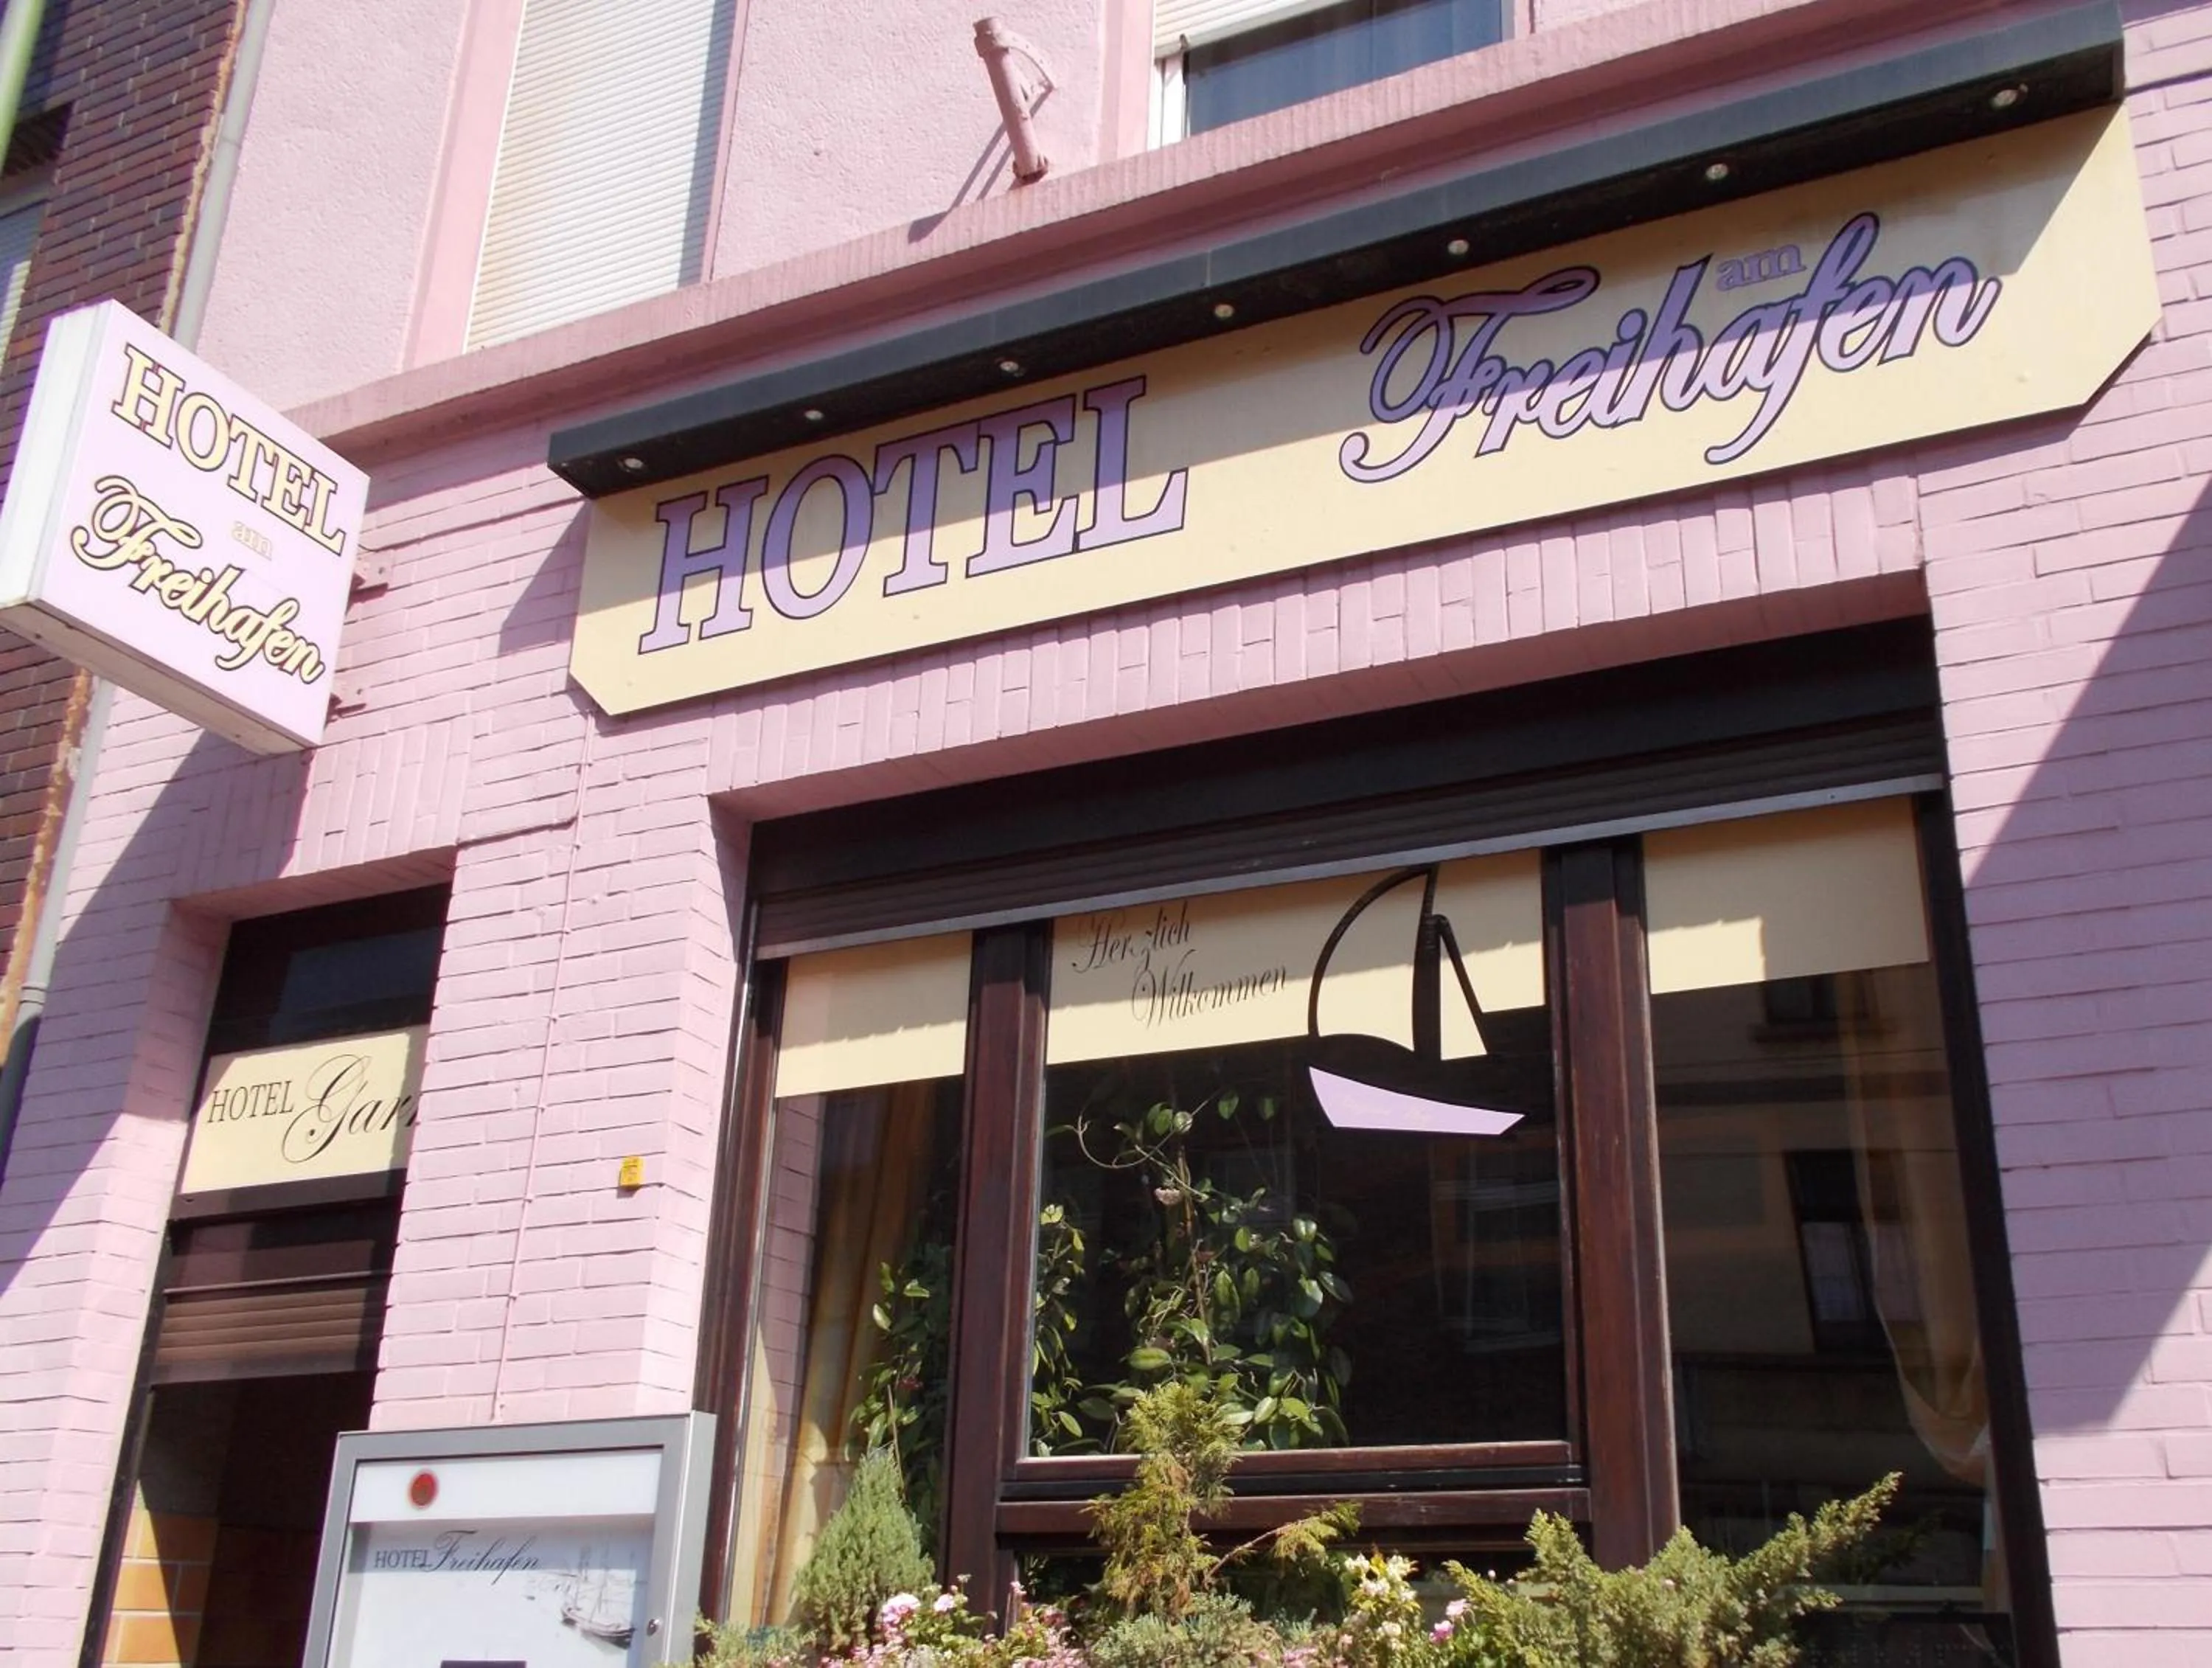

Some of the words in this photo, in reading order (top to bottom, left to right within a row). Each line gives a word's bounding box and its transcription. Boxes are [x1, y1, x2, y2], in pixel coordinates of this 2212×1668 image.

[1714, 242, 1807, 293] am
[111, 342, 347, 557] HOTEL
[637, 374, 1189, 655] HOTEL
[1338, 211, 2002, 484] Freihafen
[230, 521, 273, 561] am
[71, 474, 326, 684] Freihafen
[1071, 900, 1190, 973] Herzlich
[206, 1080, 295, 1124] HOTEL
[374, 1549, 433, 1569] HOTEL
[419, 1529, 540, 1586] Freihafen
